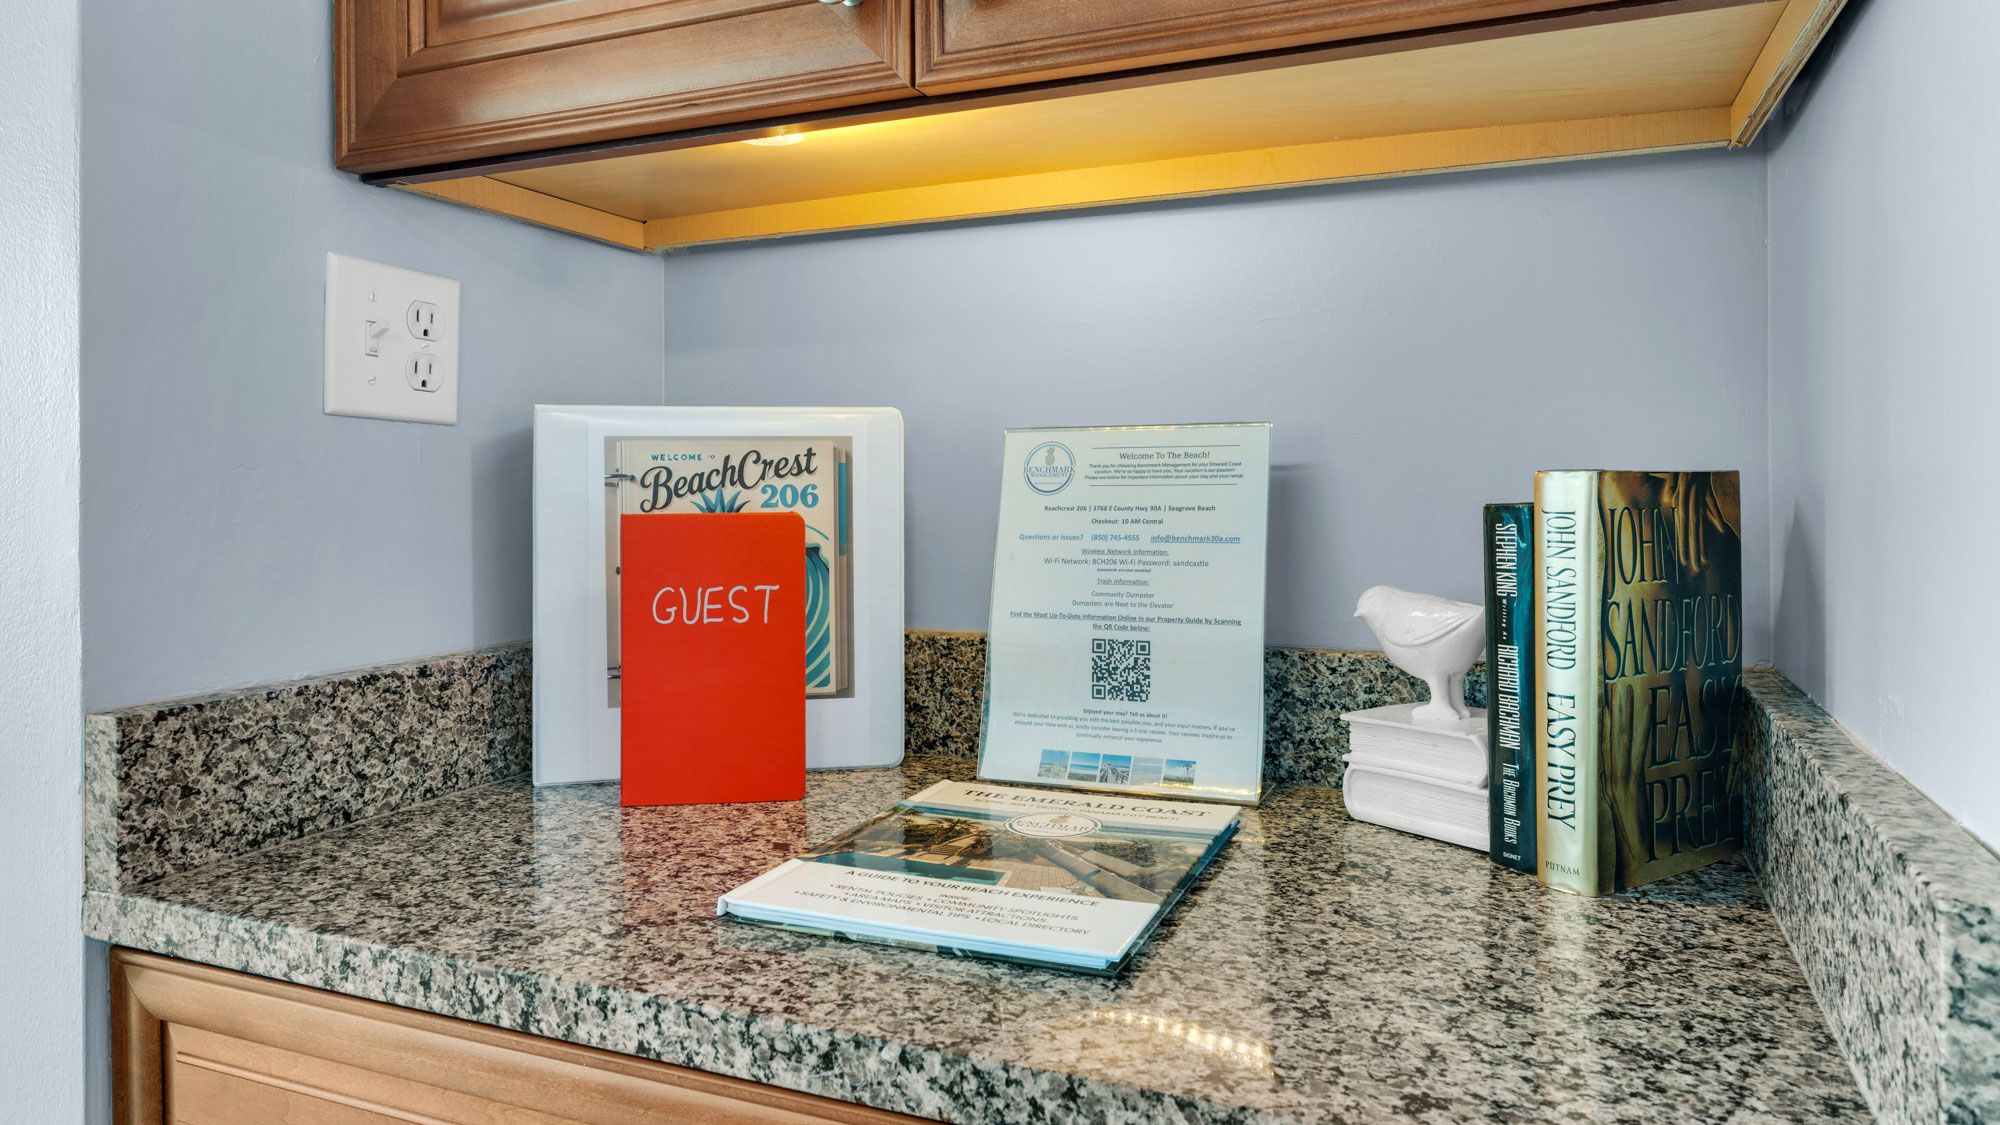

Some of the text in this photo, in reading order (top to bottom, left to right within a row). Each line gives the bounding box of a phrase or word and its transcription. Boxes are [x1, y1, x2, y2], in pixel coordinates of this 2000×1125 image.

[1119, 450, 1210, 460] Welcome To The Beach!
[640, 447, 818, 513] BeachCrest
[760, 484, 819, 509] 206
[1091, 534, 1108, 542] (850)
[1151, 535, 1240, 544] info@benchmark30a.com
[1495, 523, 1518, 569] STEPHEN
[1606, 506, 1680, 602] JOHN
[1496, 572, 1518, 597] KING
[652, 585, 780, 625] GUEST
[1158, 616, 1184, 624] Property
[1214, 618, 1242, 626] Scanning
[1605, 594, 1741, 682] SANDFORD
[1497, 644, 1520, 691] RICHARD
[1542, 509, 1577, 831] JOHN SANDFORD EASY PREY
[1498, 693, 1520, 750] BACHMAN
[1647, 674, 1741, 769] EASY
[965, 790, 1008, 798] THE
[1012, 796, 1125, 810] EMERALD
[1131, 806, 1211, 817] COAST
[1645, 760, 1741, 863] PREY
[1503, 851, 1521, 861] SIGNET
[1545, 860, 1580, 876] PUTNAM
[857, 872, 897, 881] GUIDE
[921, 880, 961, 889] YOUR
[962, 886, 1009, 895] BEACH
[1012, 891, 1099, 906] EXPERIENCE
[874, 891, 923, 899] POLICIES
[933, 899, 1004, 910] COMMUNITY
[1007, 908, 1079, 920] SPOTLIGHTS
[801, 891, 838, 899] SAFETY
[849, 899, 943, 915] ENVIRONMENTAL
[981, 917, 1022, 925] LOCAL
[1022, 922, 1091, 934] DIRECTORY
[922, 903, 967, 912] VISITOR
[966, 909, 1047, 922] ATTRACTIONS
